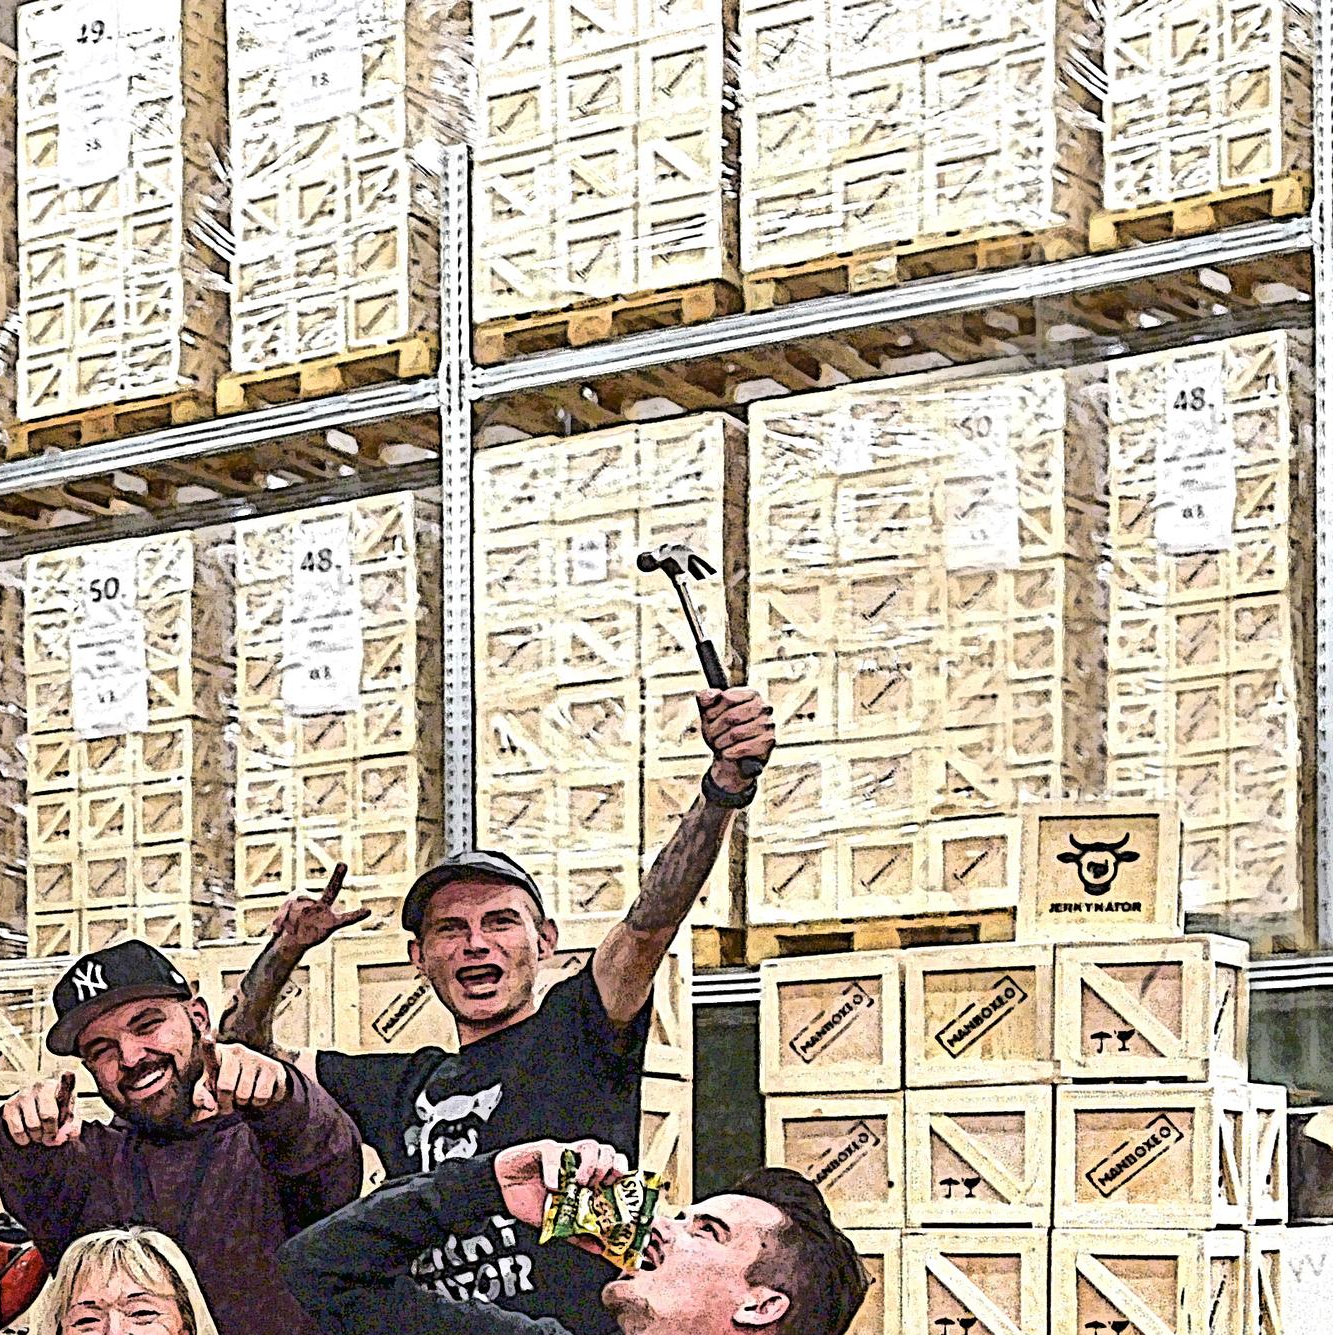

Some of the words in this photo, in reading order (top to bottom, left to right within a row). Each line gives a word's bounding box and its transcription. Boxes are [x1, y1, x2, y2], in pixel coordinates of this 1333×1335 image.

[71, 961, 107, 1001] NY
[801, 992, 864, 1061] MANBOXEO
[946, 986, 1017, 1049] MANBOXEO
[1096, 1125, 1173, 1187] MANBOXEO
